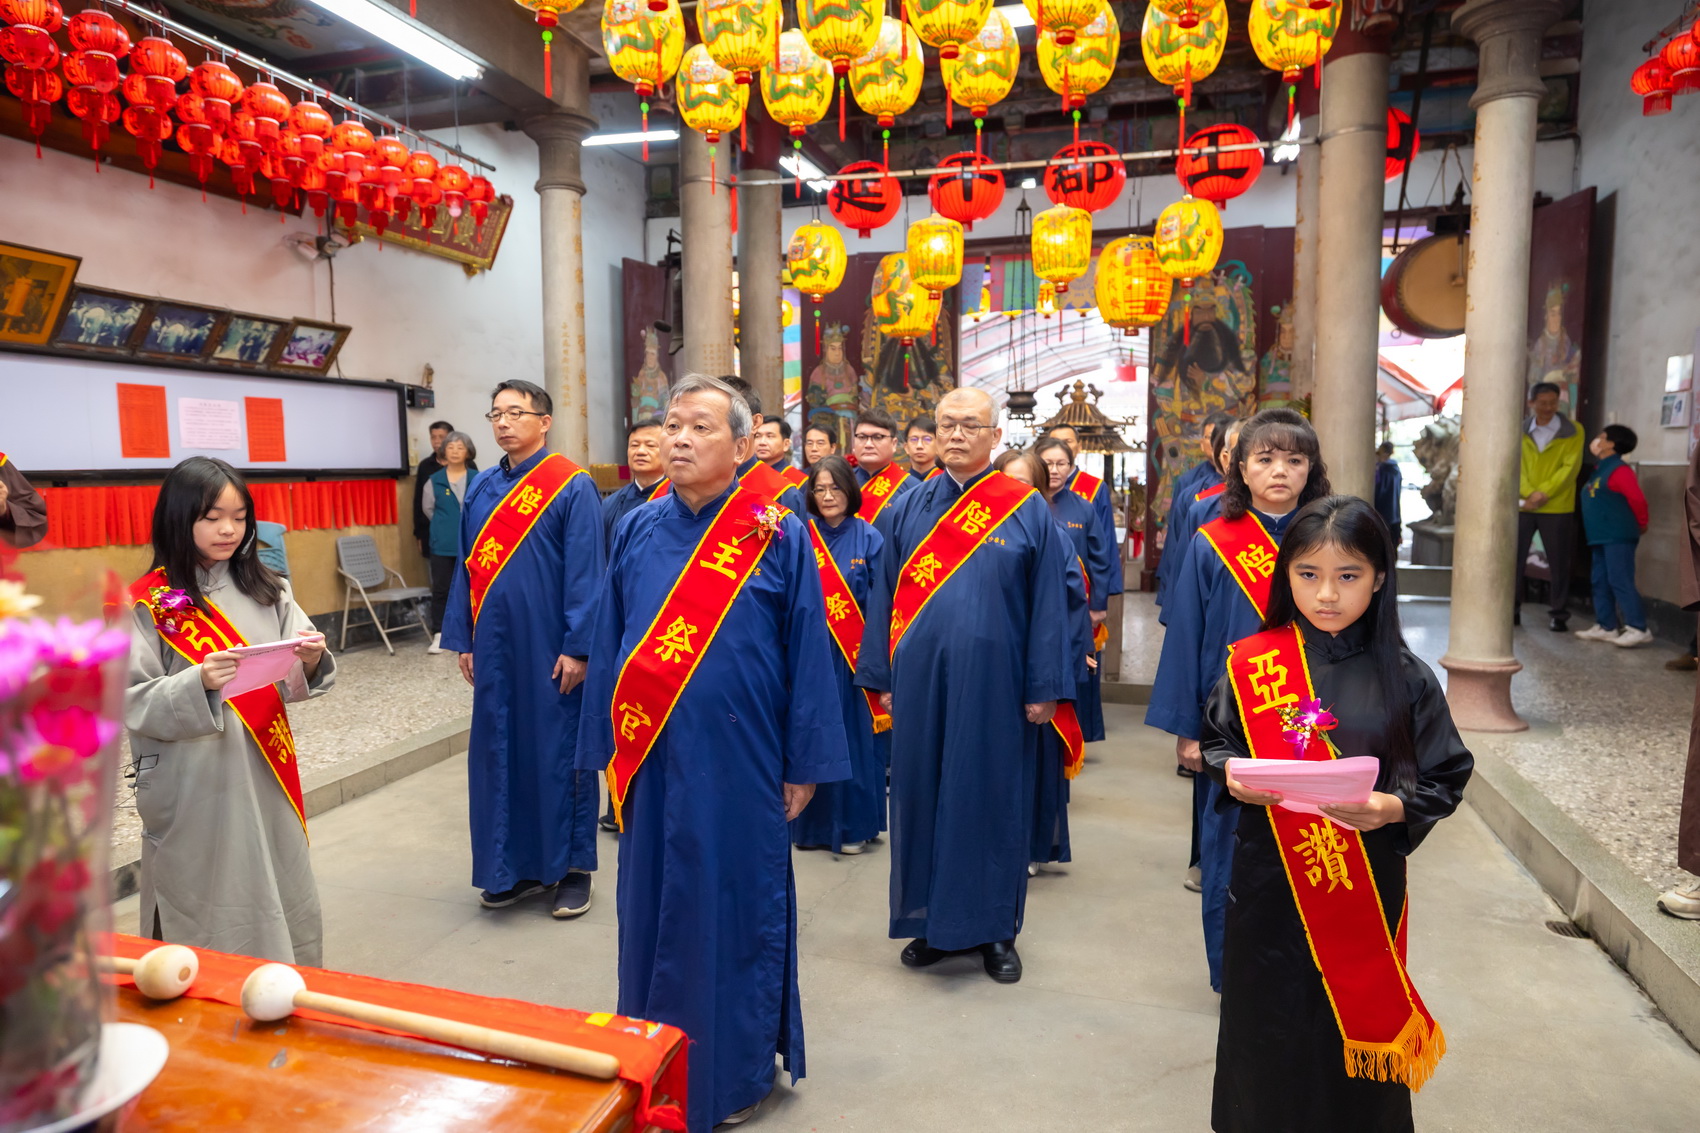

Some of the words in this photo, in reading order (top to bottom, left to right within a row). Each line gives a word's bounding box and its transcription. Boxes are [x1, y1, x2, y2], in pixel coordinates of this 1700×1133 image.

[470, 484, 544, 608] 陪祭
[618, 535, 744, 744] 主祭官
